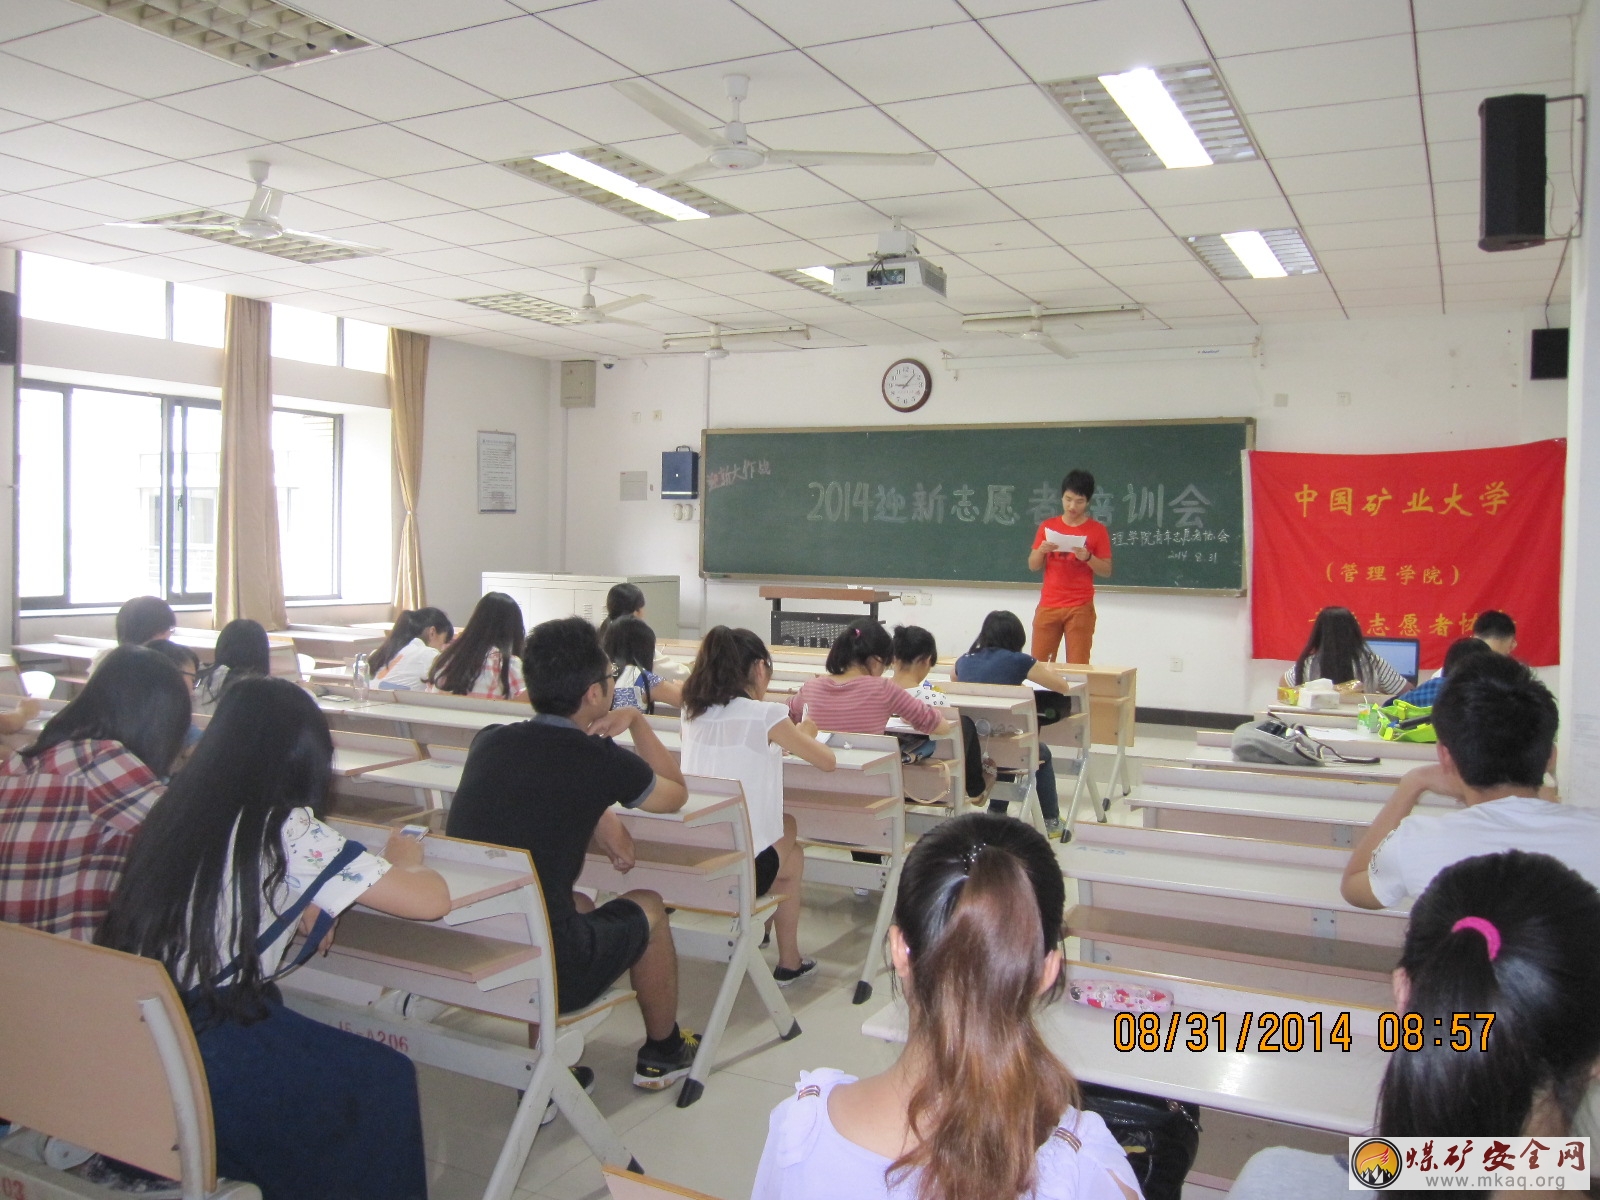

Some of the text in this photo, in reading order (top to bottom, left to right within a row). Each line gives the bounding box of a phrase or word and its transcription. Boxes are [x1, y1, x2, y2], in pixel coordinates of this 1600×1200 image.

[1294, 480, 1511, 518] 中国矿业大学
